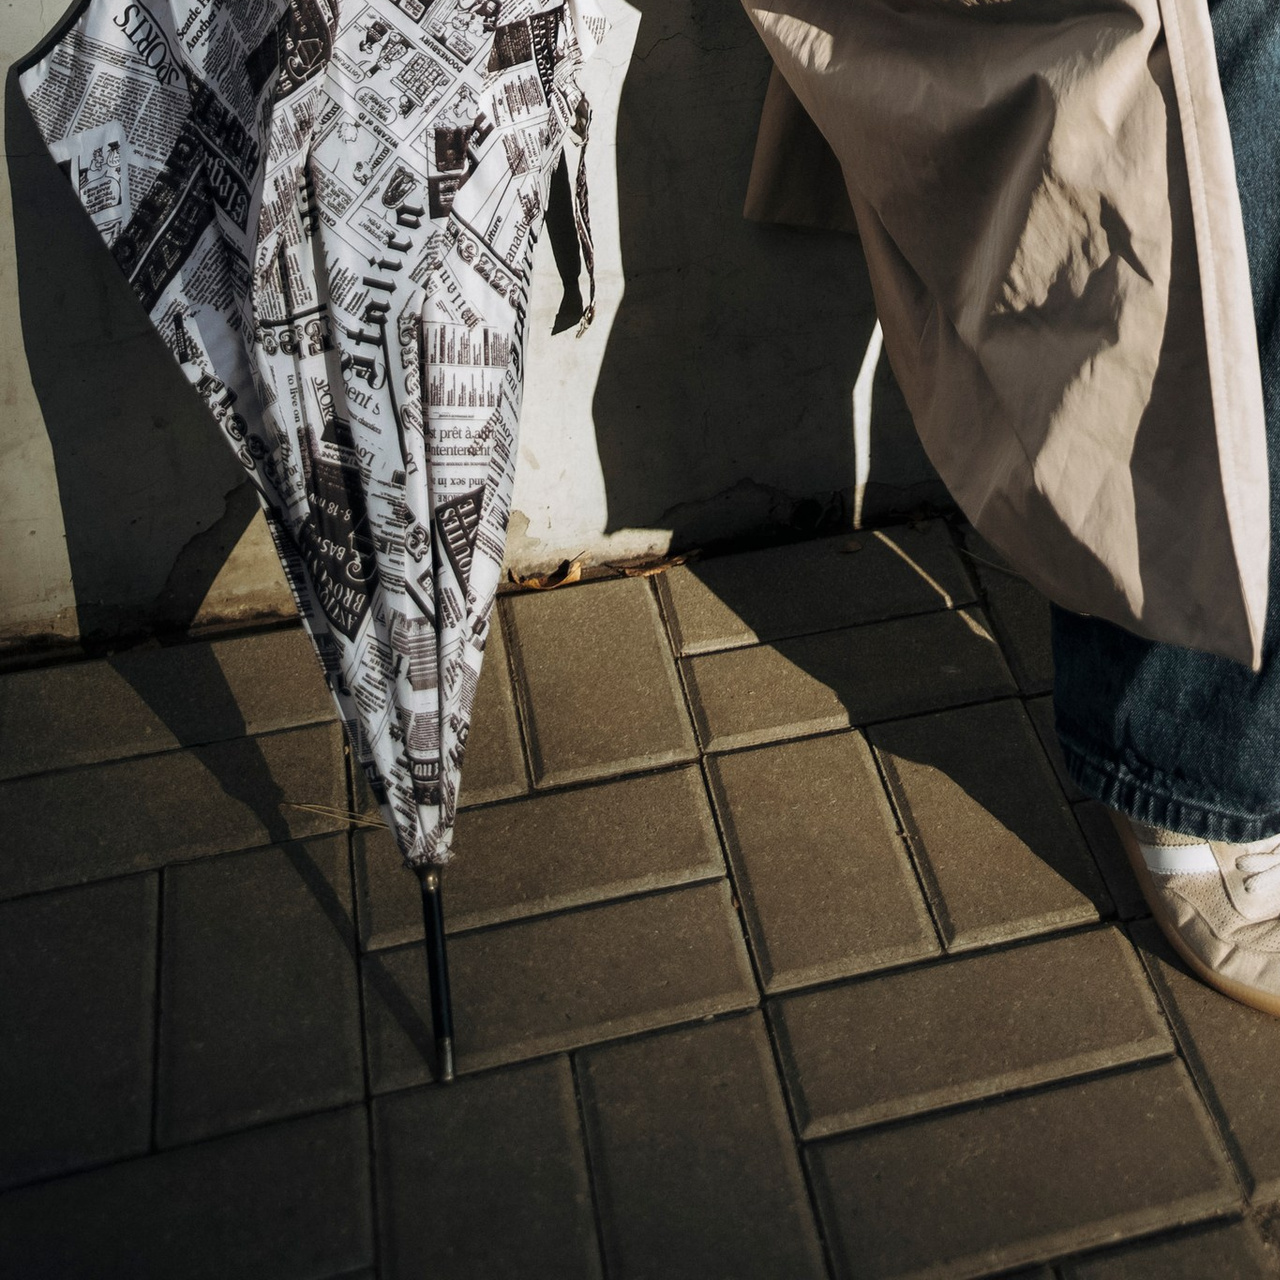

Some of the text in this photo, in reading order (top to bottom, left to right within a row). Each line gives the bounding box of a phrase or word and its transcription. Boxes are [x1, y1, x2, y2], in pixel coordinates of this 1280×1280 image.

[186, 11, 215, 53] Another
[113, 3, 180, 87] SPORTS
[419, 35, 465, 74] DOONESBURY
[373, 124, 400, 150] WIZARD
[289, 387, 300, 408] live
[293, 408, 302, 424] on
[440, 425, 463, 443] prêt
[437, 477, 448, 487] in
[450, 478, 466, 486] sex
